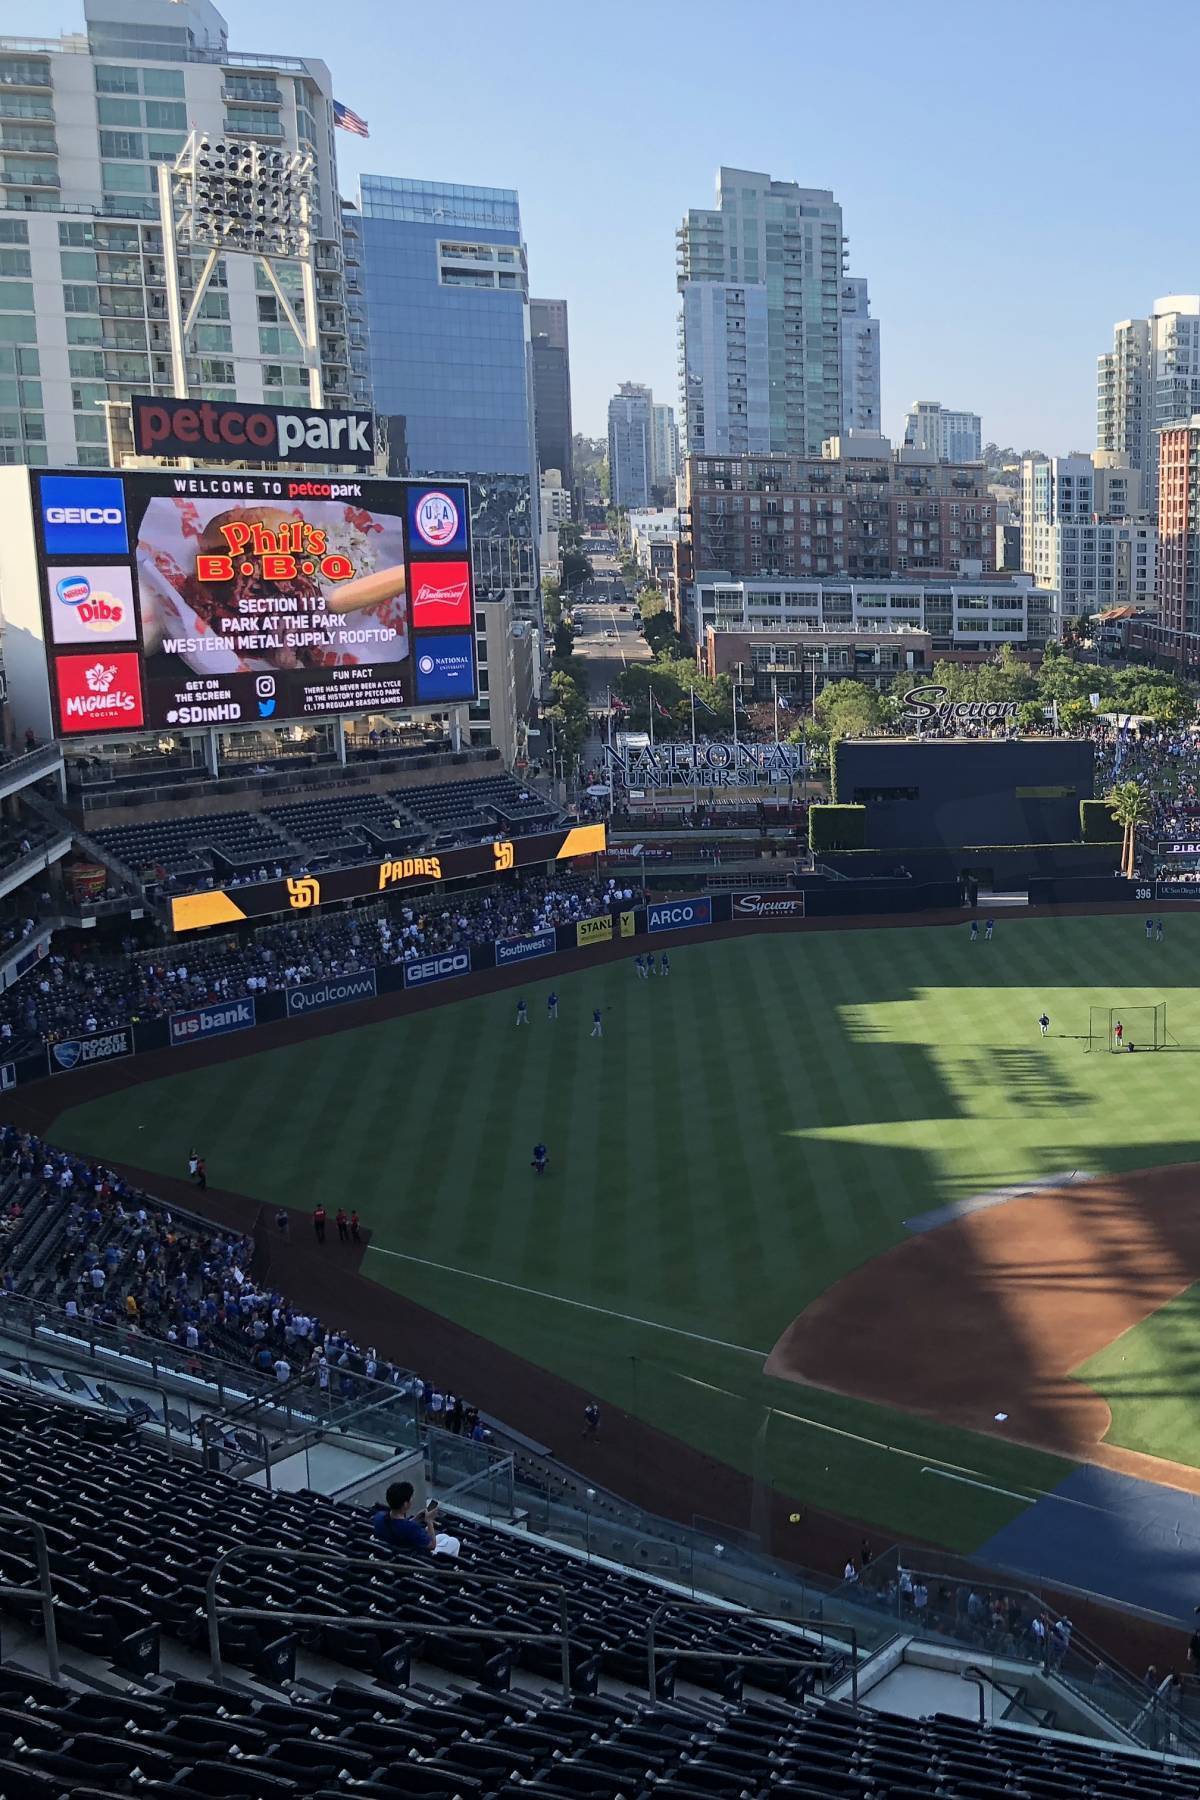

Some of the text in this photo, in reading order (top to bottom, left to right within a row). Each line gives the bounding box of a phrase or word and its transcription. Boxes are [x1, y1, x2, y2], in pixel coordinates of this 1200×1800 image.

[174, 479, 254, 494] WELCOME
[263, 482, 282, 495] TO
[46, 507, 122, 524] GEICO
[77, 599, 122, 622] Dibs
[239, 597, 326, 613] SECTION 113
[221, 614, 346, 632] PARK AT THE PARK
[162, 628, 397, 654] WESTERN METAL SUPPLY ROOFTOP
[435, 656, 468, 664] NATIONAL
[333, 669, 373, 680] FUN FACT
[185, 679, 219, 691] GET ON
[304, 686, 324, 694] THERE
[340, 684, 359, 692] NEVER
[383, 680, 402, 688] CYCLE
[327, 692, 354, 700] HISTORY
[364, 690, 384, 698] PETCO
[385, 688, 400, 696] PARK
[175, 690, 231, 703] THE SCREEN
[326, 701, 354, 709] REGULAR
[355, 698, 380, 706] SEASON
[381, 696, 403, 704] GAMES)
[902, 684, 1021, 728] Sycuan
[602, 743, 813, 770] NATIONAL
[622, 769, 799, 789] UNIVERSITY
[378, 856, 442, 890] PADRES
[1135, 888, 1151, 899] 396
[740, 895, 797, 915] Sycuan
[580, 916, 629, 935] STANLY
[650, 907, 694, 926] ARCO
[500, 938, 545, 958] Southwest
[407, 955, 468, 981] GEICO
[290, 979, 373, 1009] Qualcomm
[81, 1032, 126, 1051] ROCKET
[82, 1042, 127, 1061] LEAGUE
